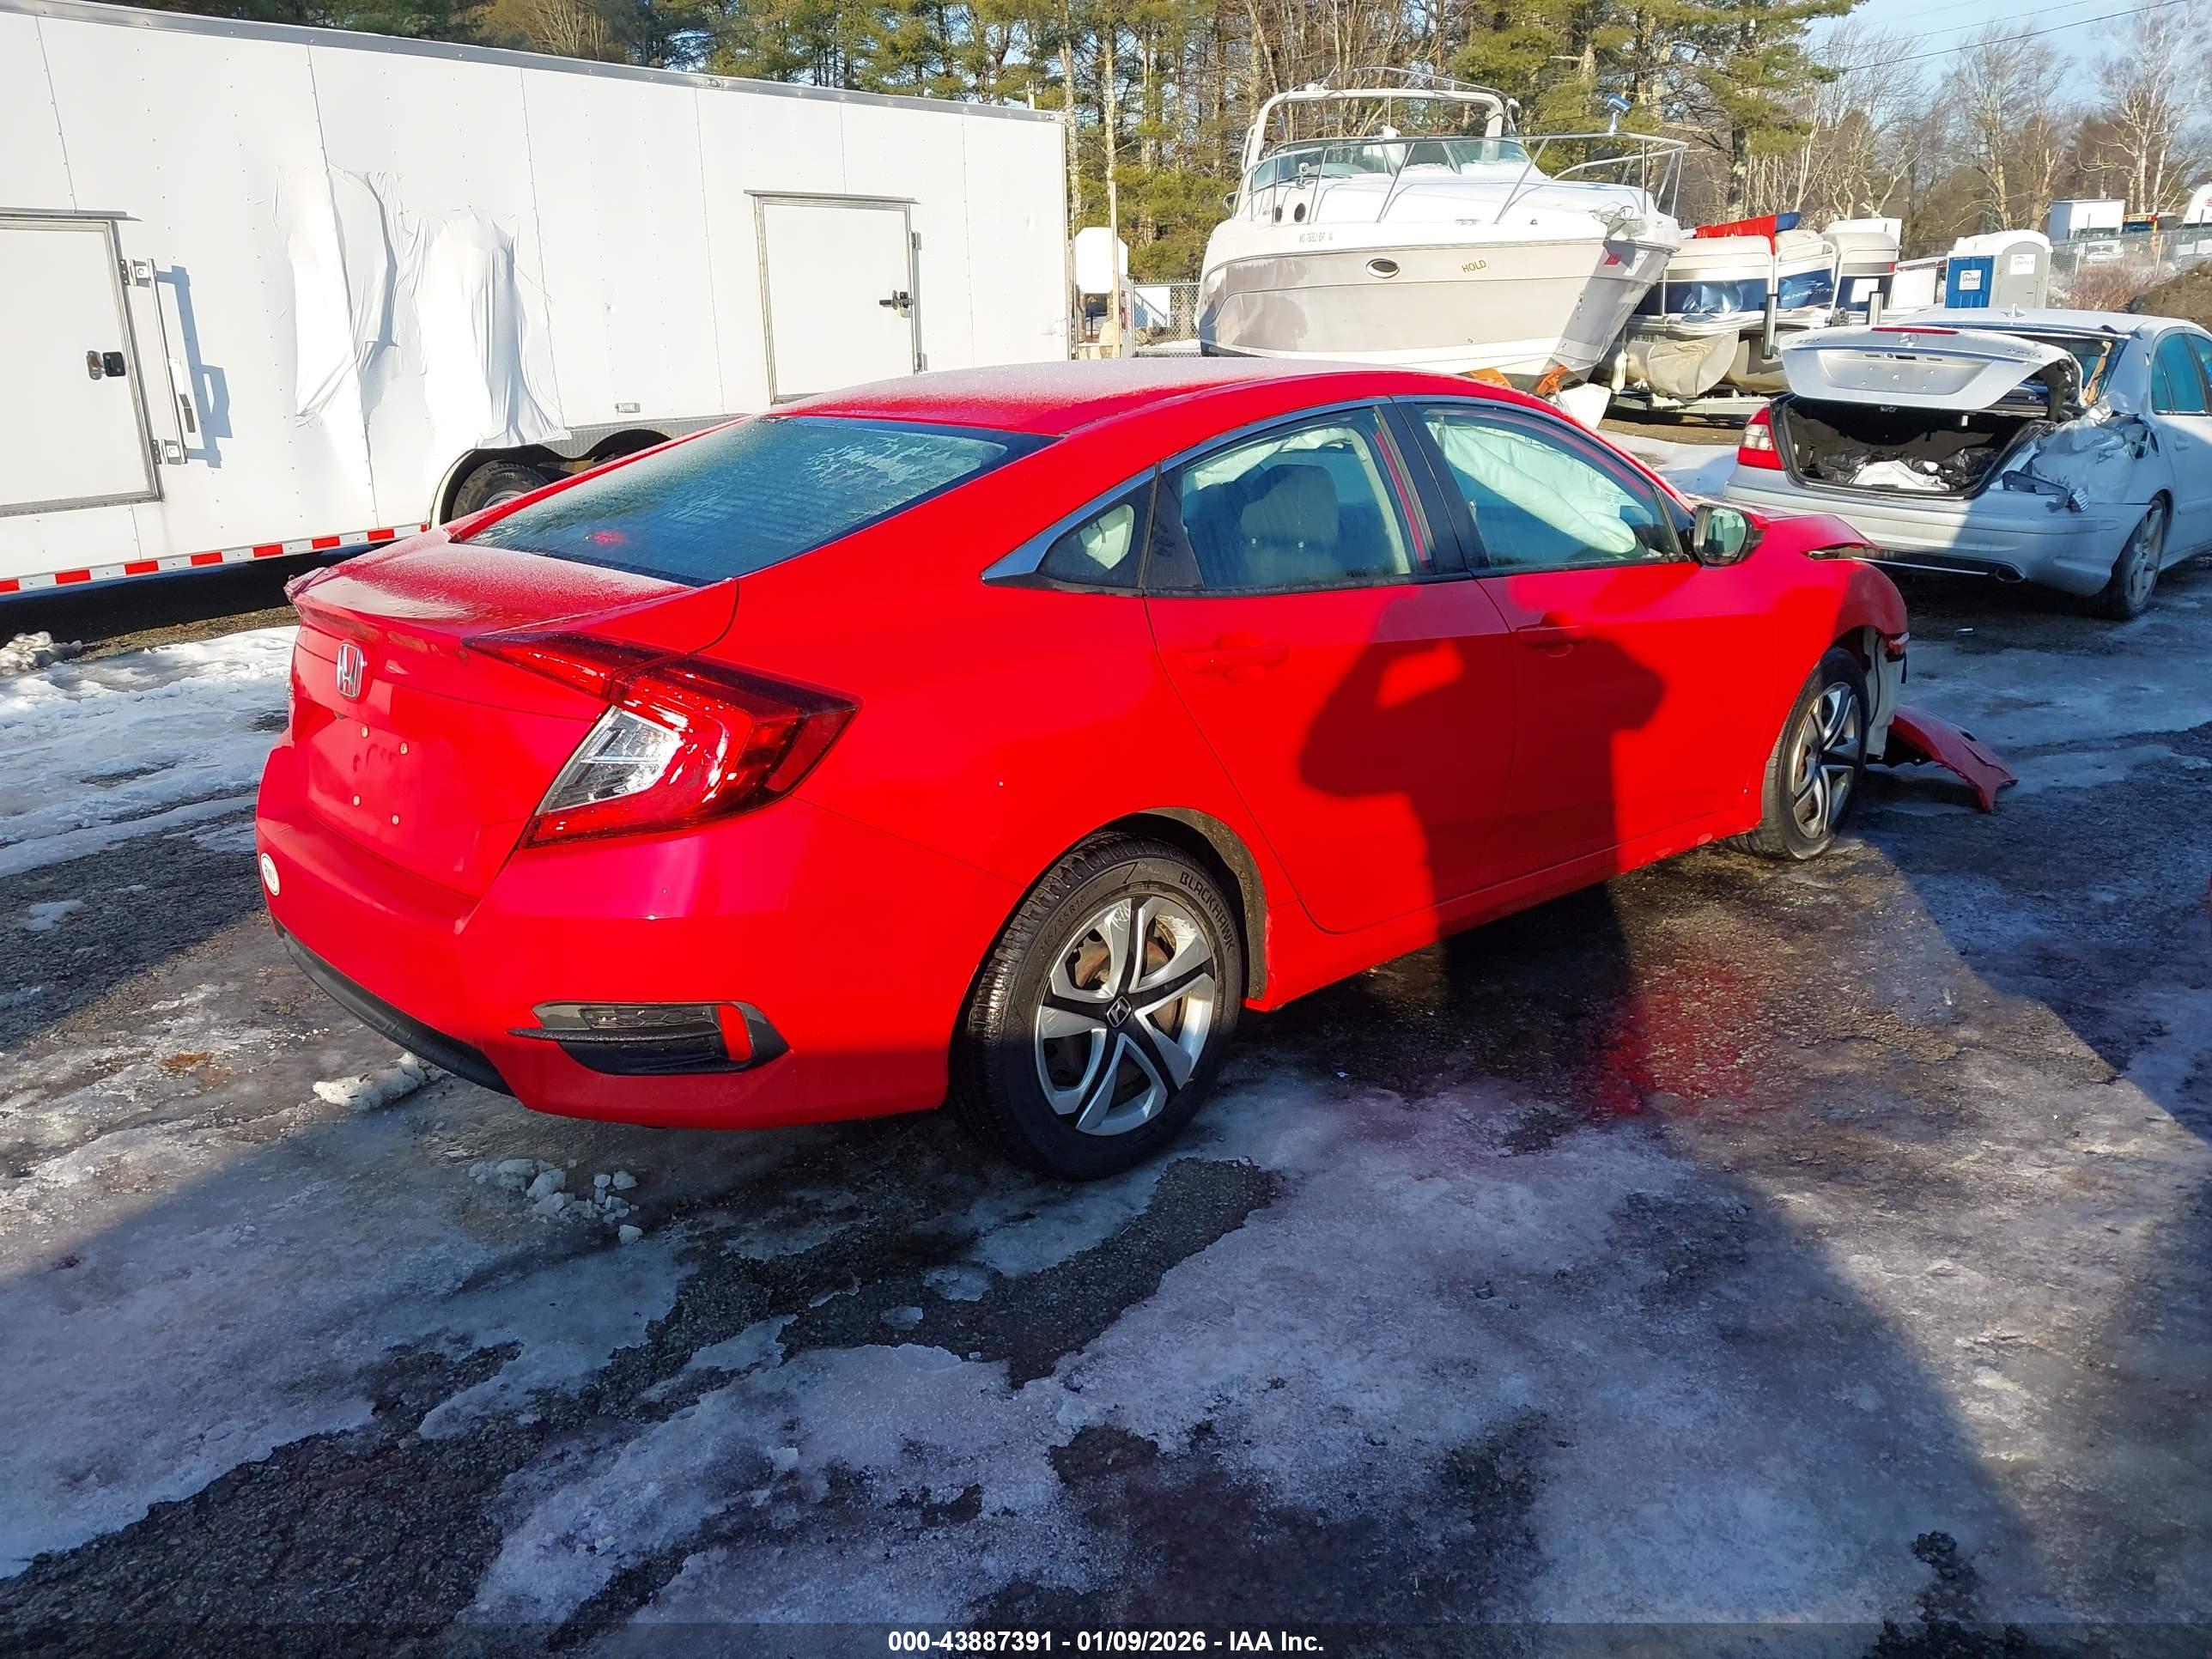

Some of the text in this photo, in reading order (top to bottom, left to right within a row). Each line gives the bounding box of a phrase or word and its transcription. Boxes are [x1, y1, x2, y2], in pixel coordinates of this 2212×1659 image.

[1462, 259, 1486, 273] HOLD
[1962, 275, 1980, 283] United
[1179, 871, 1236, 952] BLACKHAWK
